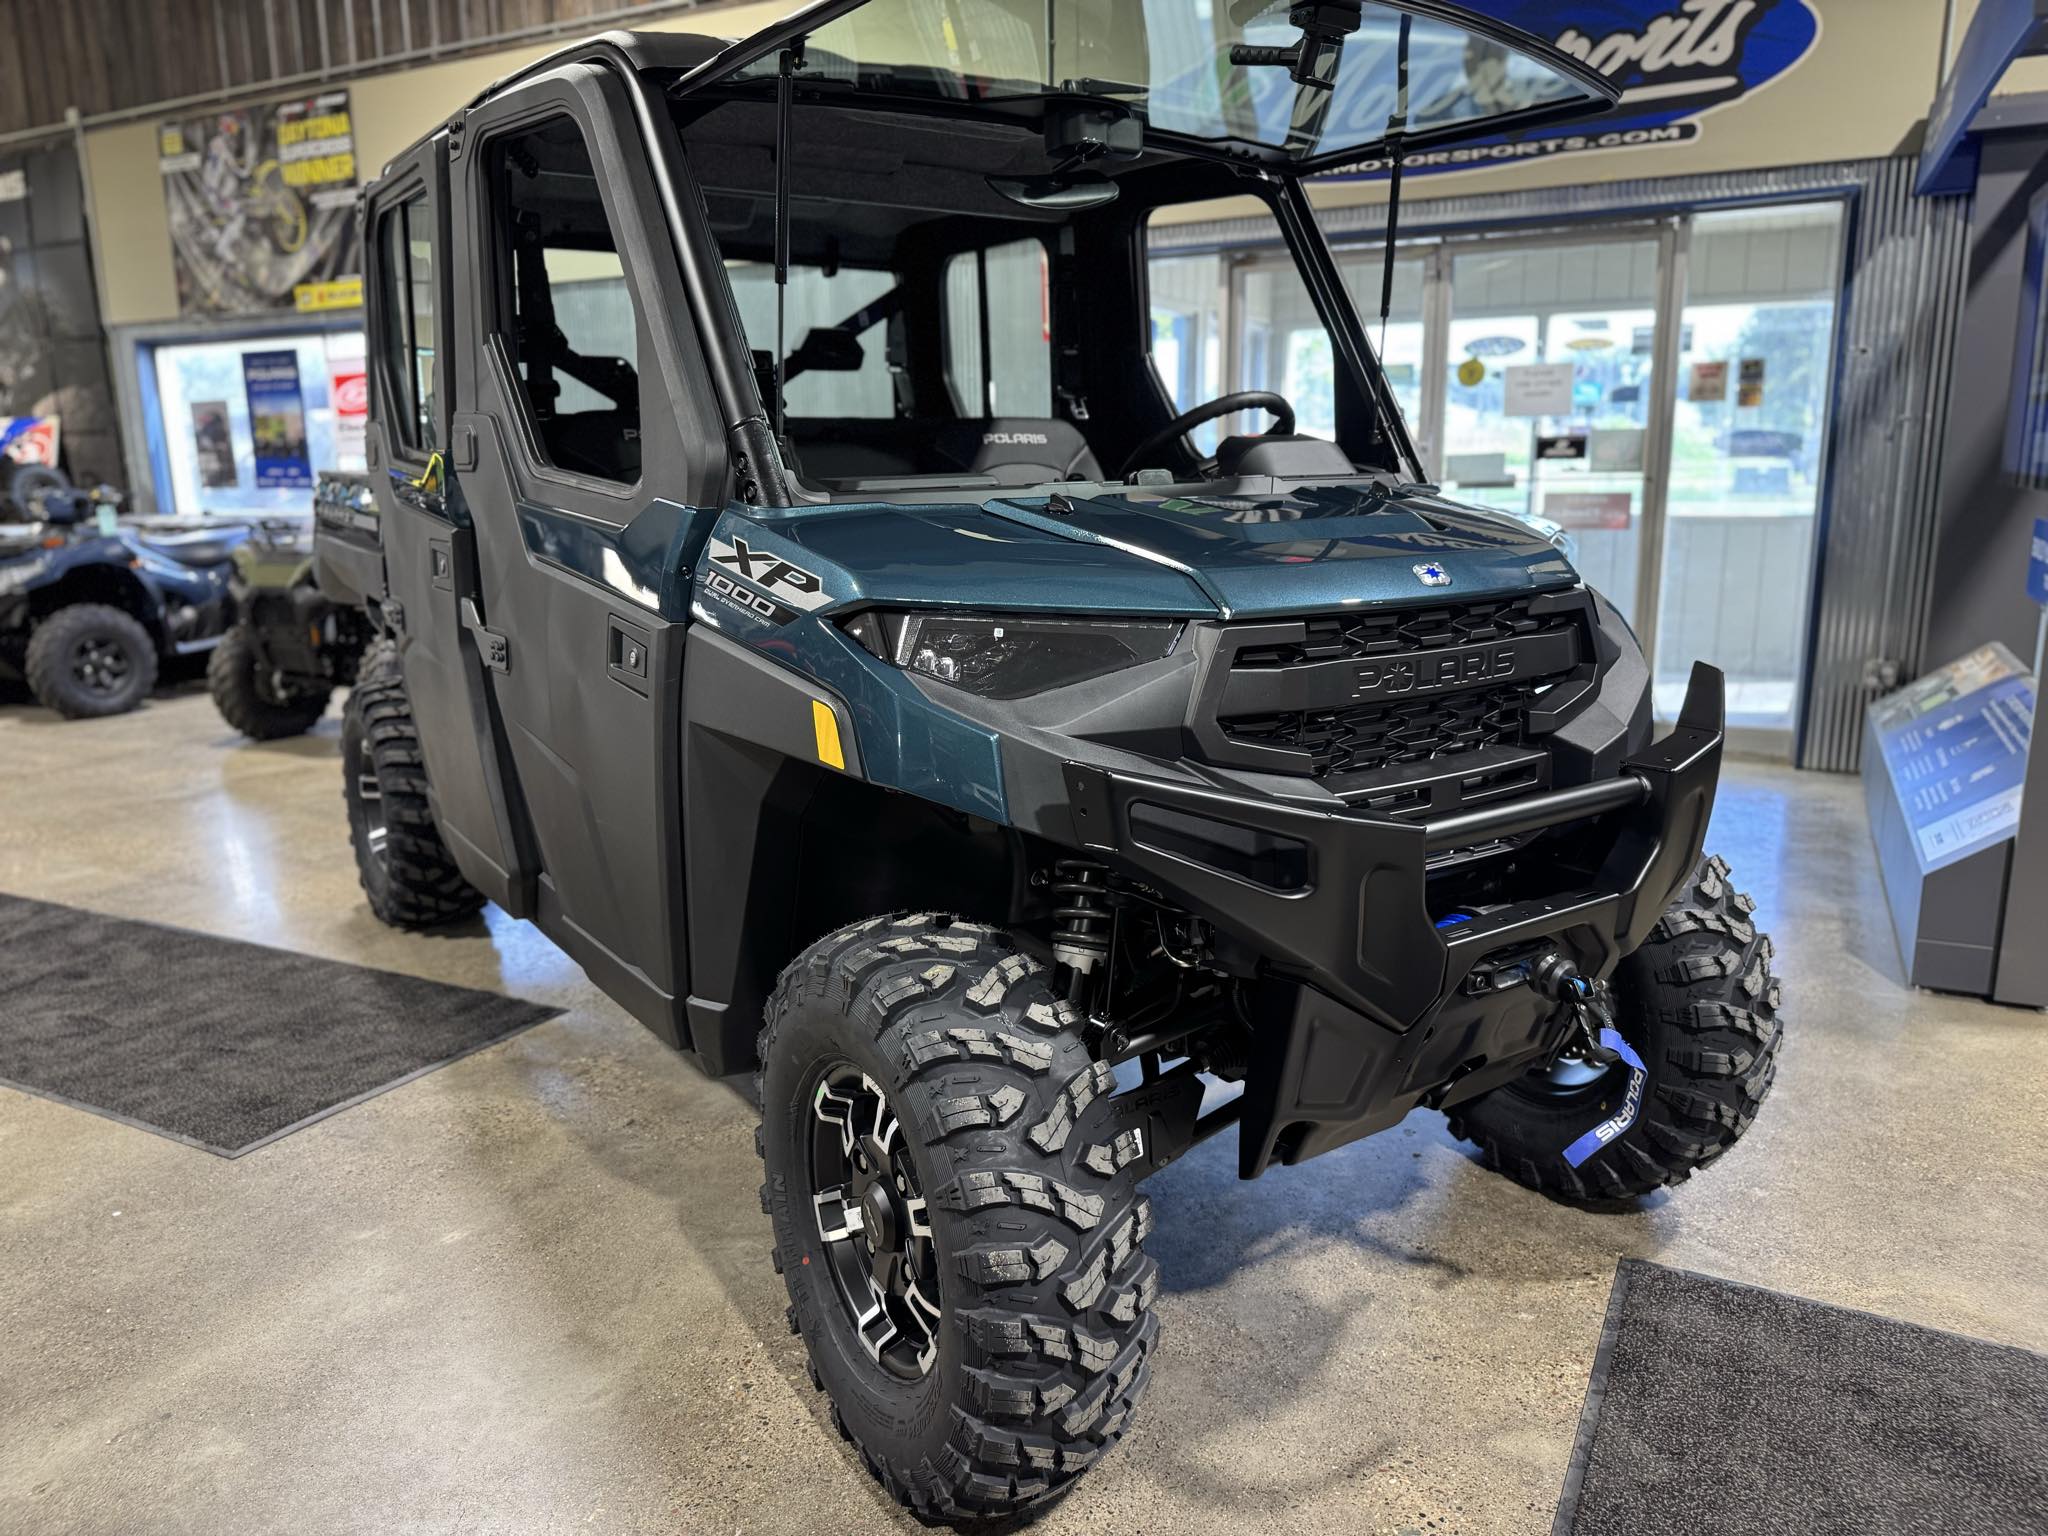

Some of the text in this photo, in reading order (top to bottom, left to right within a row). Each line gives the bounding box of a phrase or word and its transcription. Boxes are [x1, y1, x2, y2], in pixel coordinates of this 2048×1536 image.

[983, 433, 1048, 445] POLARIS
[709, 535, 822, 594] XP
[704, 571, 776, 617] 1000
[1352, 648, 1515, 698] POLARIS
[1594, 1067, 1643, 1142] POLARIS
